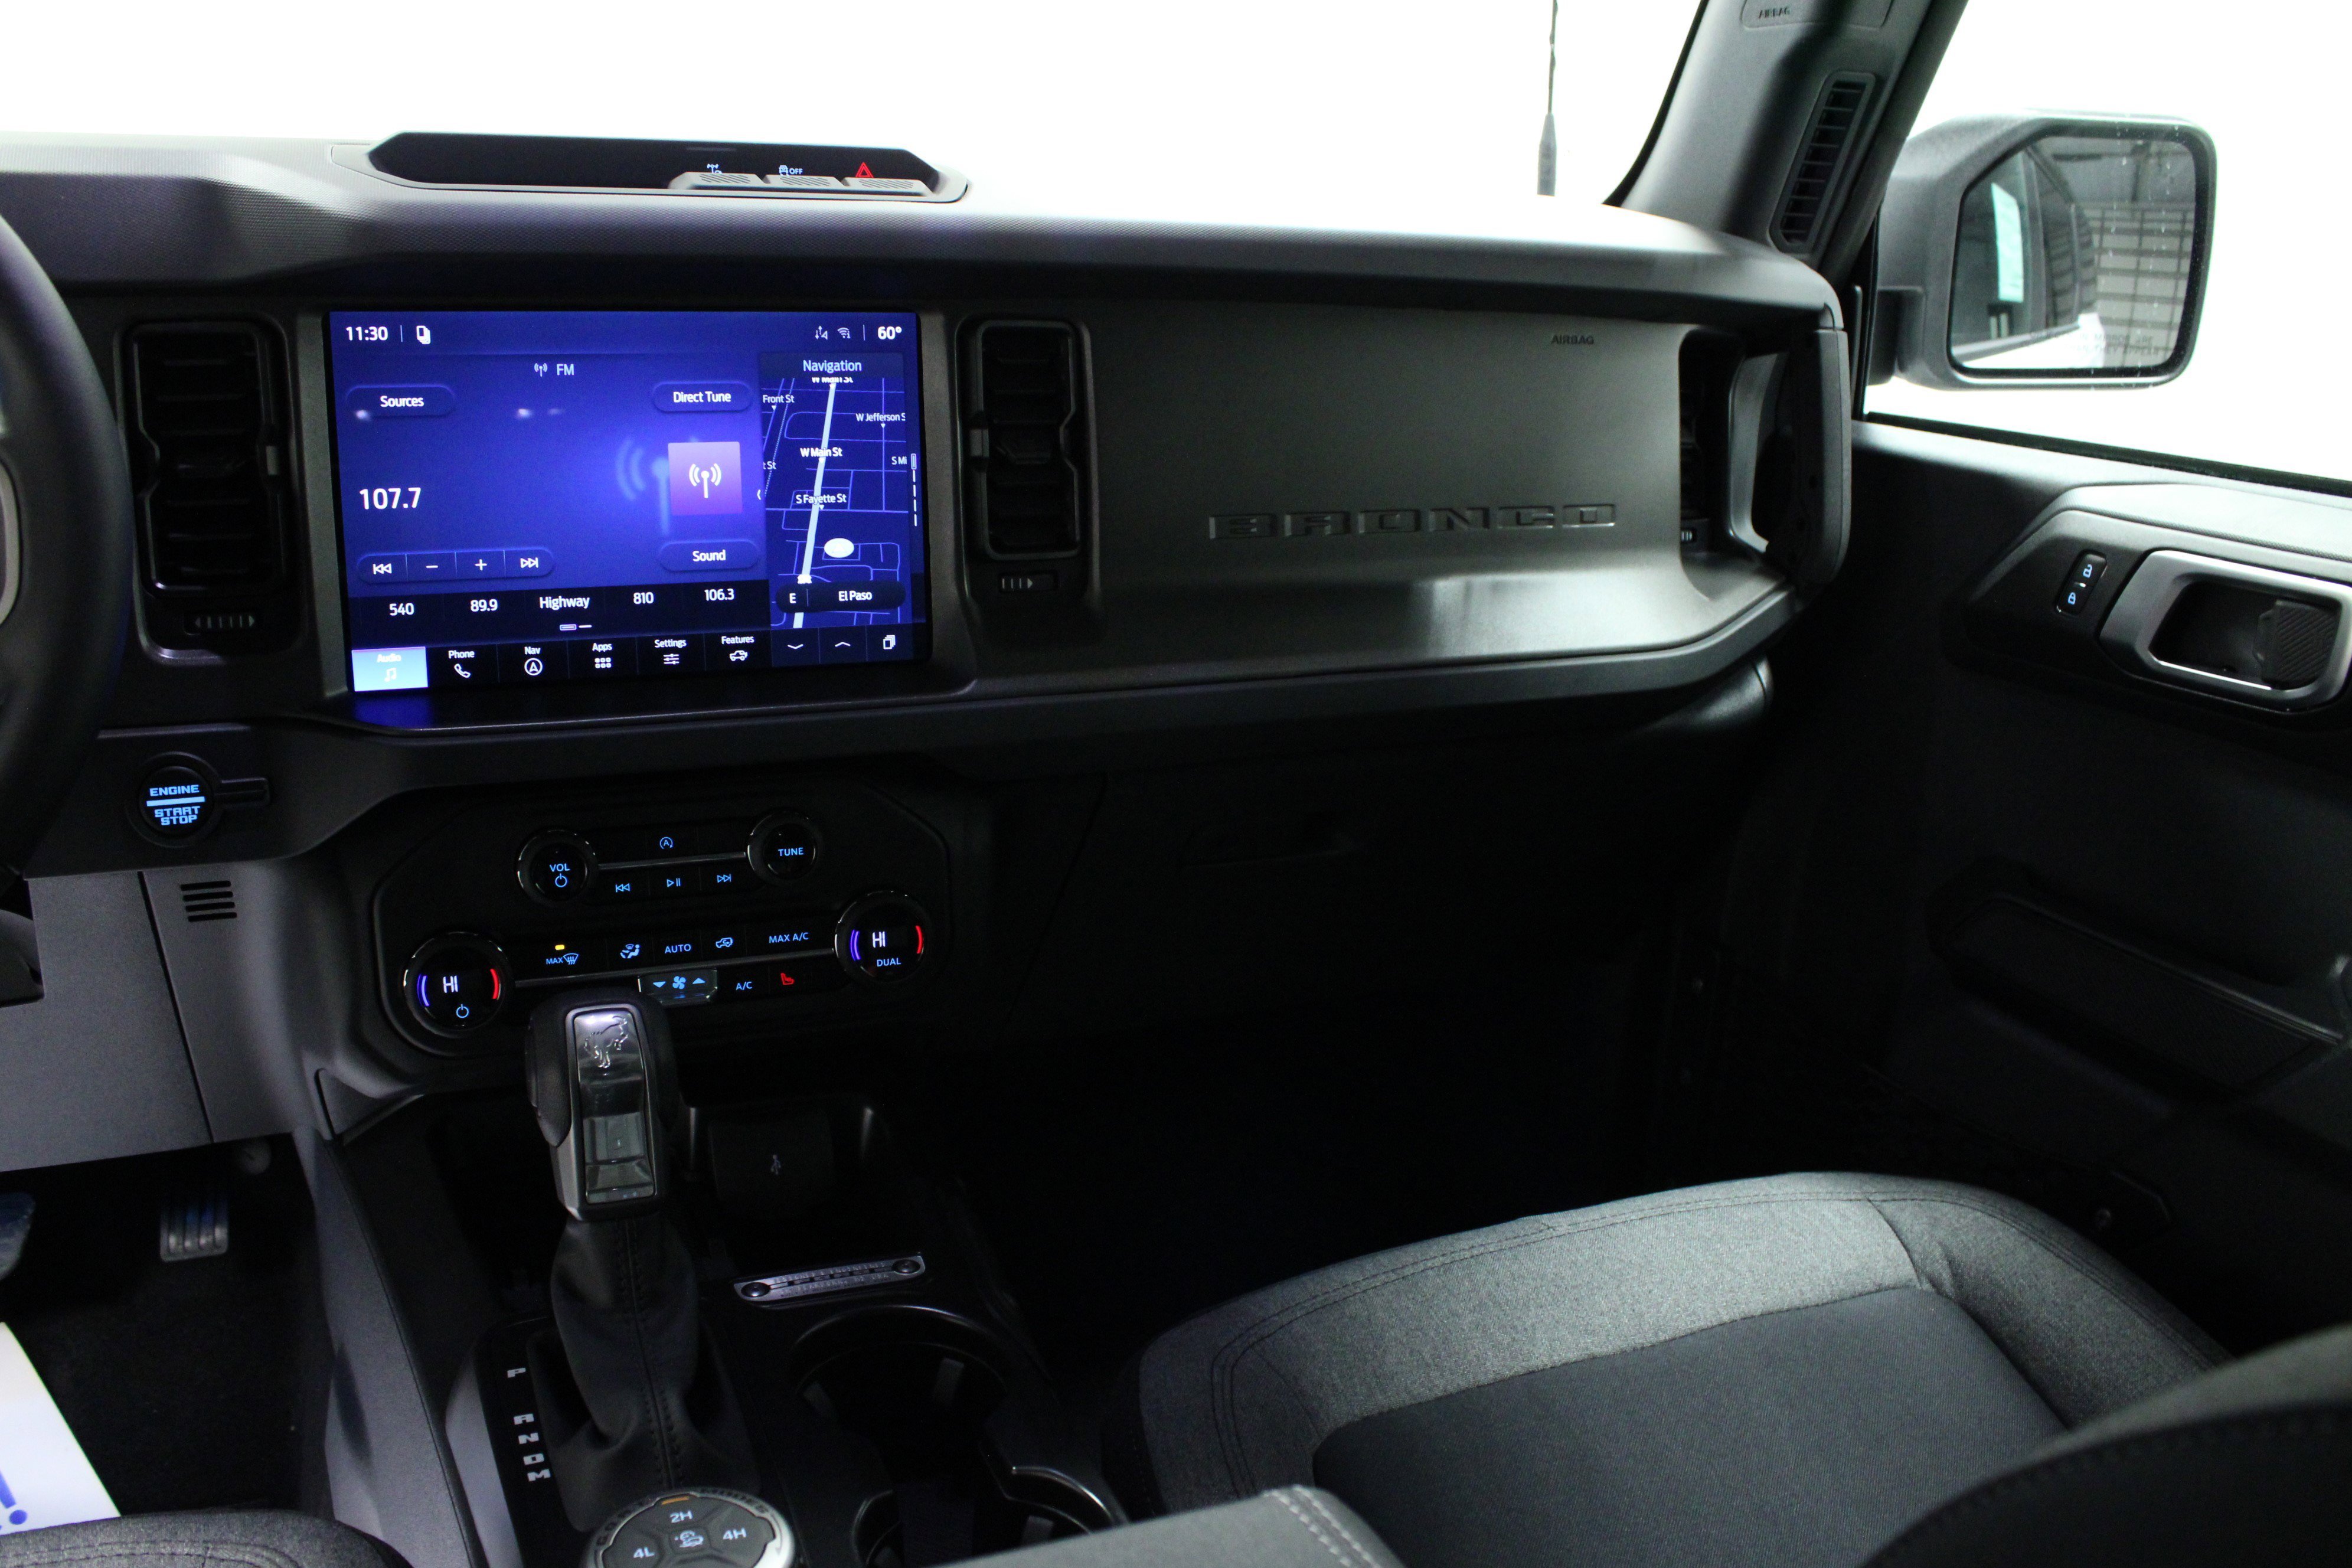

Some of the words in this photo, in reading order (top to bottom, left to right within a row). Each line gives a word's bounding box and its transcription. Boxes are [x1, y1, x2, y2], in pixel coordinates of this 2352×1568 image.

[345, 325, 388, 341] 11:30
[556, 364, 575, 376] FM
[803, 360, 862, 374] Navigation
[380, 396, 424, 407] Sources
[673, 392, 704, 403] Direct
[704, 391, 731, 402] Tune
[762, 394, 785, 403] Front
[785, 394, 795, 403] St
[855, 413, 864, 422] W
[865, 412, 899, 422] Jefferson
[800, 447, 810, 458] W
[810, 447, 832, 457] Main
[832, 447, 842, 456] St
[767, 461, 777, 469] St
[891, 456, 897, 465] S
[359, 486, 422, 509] 107.7
[796, 495, 802, 505] S
[803, 494, 837, 505] Fayette
[837, 493, 847, 502] St
[1208, 503, 1616, 540] BRONCO
[692, 549, 726, 561] Sound
[633, 592, 654, 605] 810
[704, 588, 735, 601] 106.3
[789, 593, 796, 604] E
[838, 591, 848, 602] El
[849, 590, 873, 600] Paso
[470, 599, 498, 612] 89.9
[539, 595, 590, 610] Highway
[389, 603, 414, 616] 540
[654, 638, 687, 649] Settings
[721, 635, 755, 645] Features
[524, 646, 541, 655] Nav
[592, 642, 613, 652] Apps
[377, 653, 401, 663] Audio
[448, 650, 475, 659] Phone
[149, 785, 200, 796] ENGINE
[154, 806, 201, 818] START
[161, 815, 197, 826] STOP
[778, 847, 804, 857] TUNE
[549, 863, 570, 873] VOL
[769, 933, 791, 945] MAX
[792, 931, 809, 942] A/C
[872, 930, 886, 949] HI
[664, 943, 691, 955] AUTO
[545, 957, 563, 965] MAX
[876, 958, 901, 967] DUAL
[443, 975, 458, 993] HI
[736, 981, 753, 991] A/C
[507, 1367, 526, 1378] P
[518, 1432, 539, 1445] N
[527, 1468, 551, 1482] M
[669, 1510, 692, 1523] 2H
[723, 1527, 747, 1540] 4H
[633, 1547, 655, 1559] 4L
